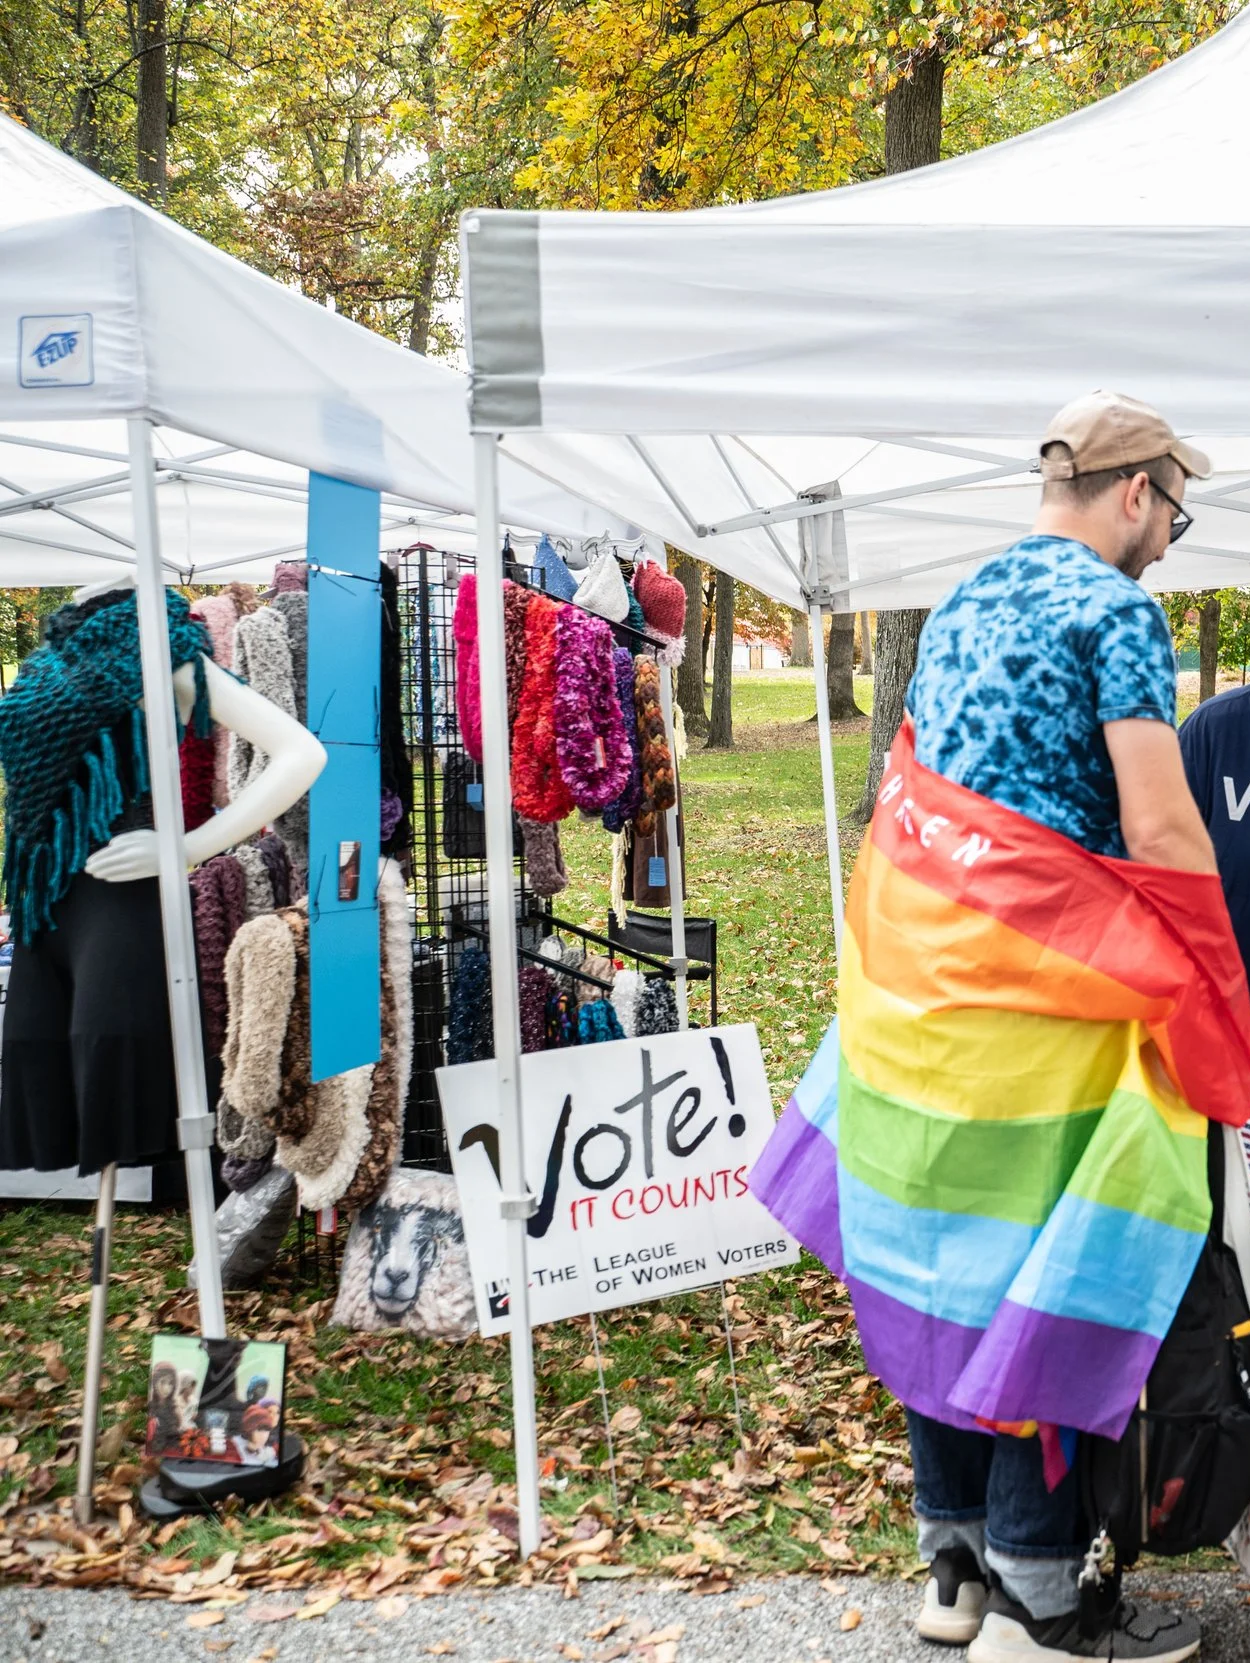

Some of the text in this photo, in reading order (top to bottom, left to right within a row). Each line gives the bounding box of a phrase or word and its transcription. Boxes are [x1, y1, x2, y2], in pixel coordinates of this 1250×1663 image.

[570, 1165, 750, 1231] IT COUNTS
[532, 1242, 677, 1286] THE LEAGUE
[632, 1258, 706, 1285] WOMEN
[717, 1239, 787, 1265] VOTERS
